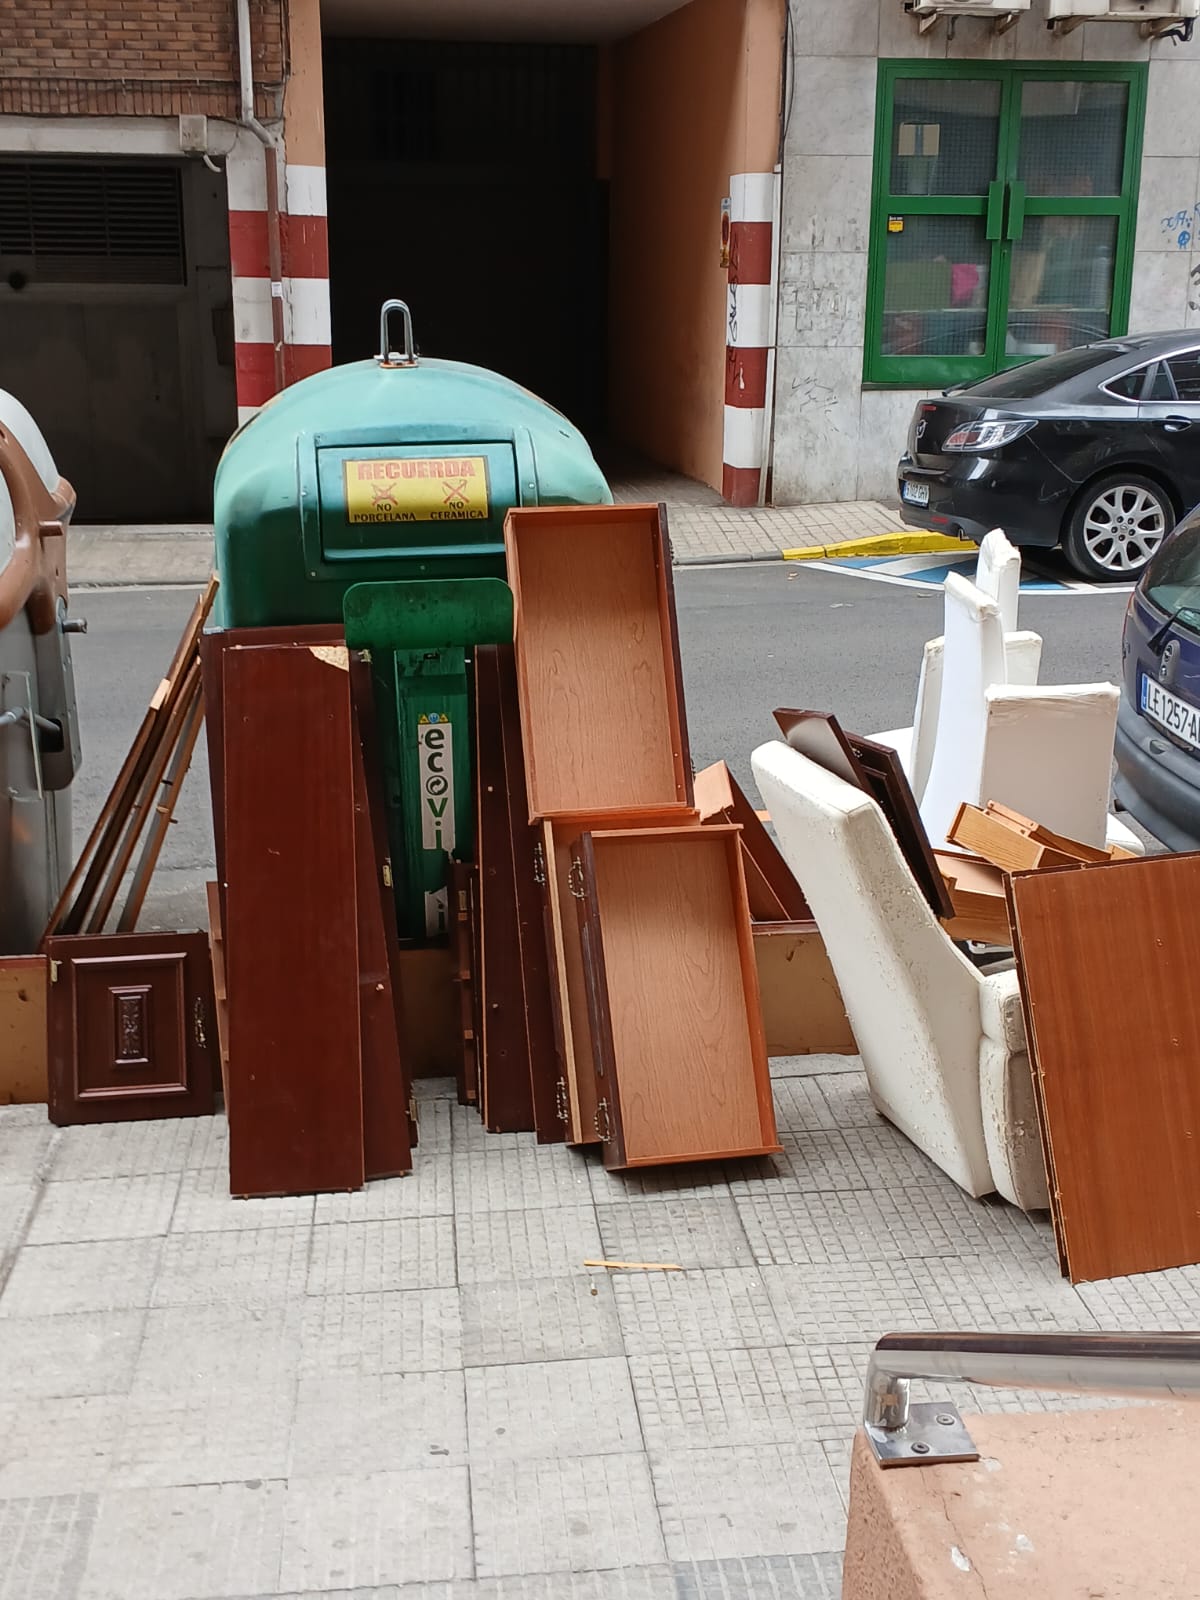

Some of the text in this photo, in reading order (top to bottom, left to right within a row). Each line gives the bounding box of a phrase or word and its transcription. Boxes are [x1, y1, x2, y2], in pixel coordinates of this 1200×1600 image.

[357, 460, 475, 480] RECUERDA
[376, 503, 392, 511] NO
[450, 501, 464, 509] NO
[354, 512, 416, 522] PORCELANA
[430, 510, 484, 520] CERAMICA
